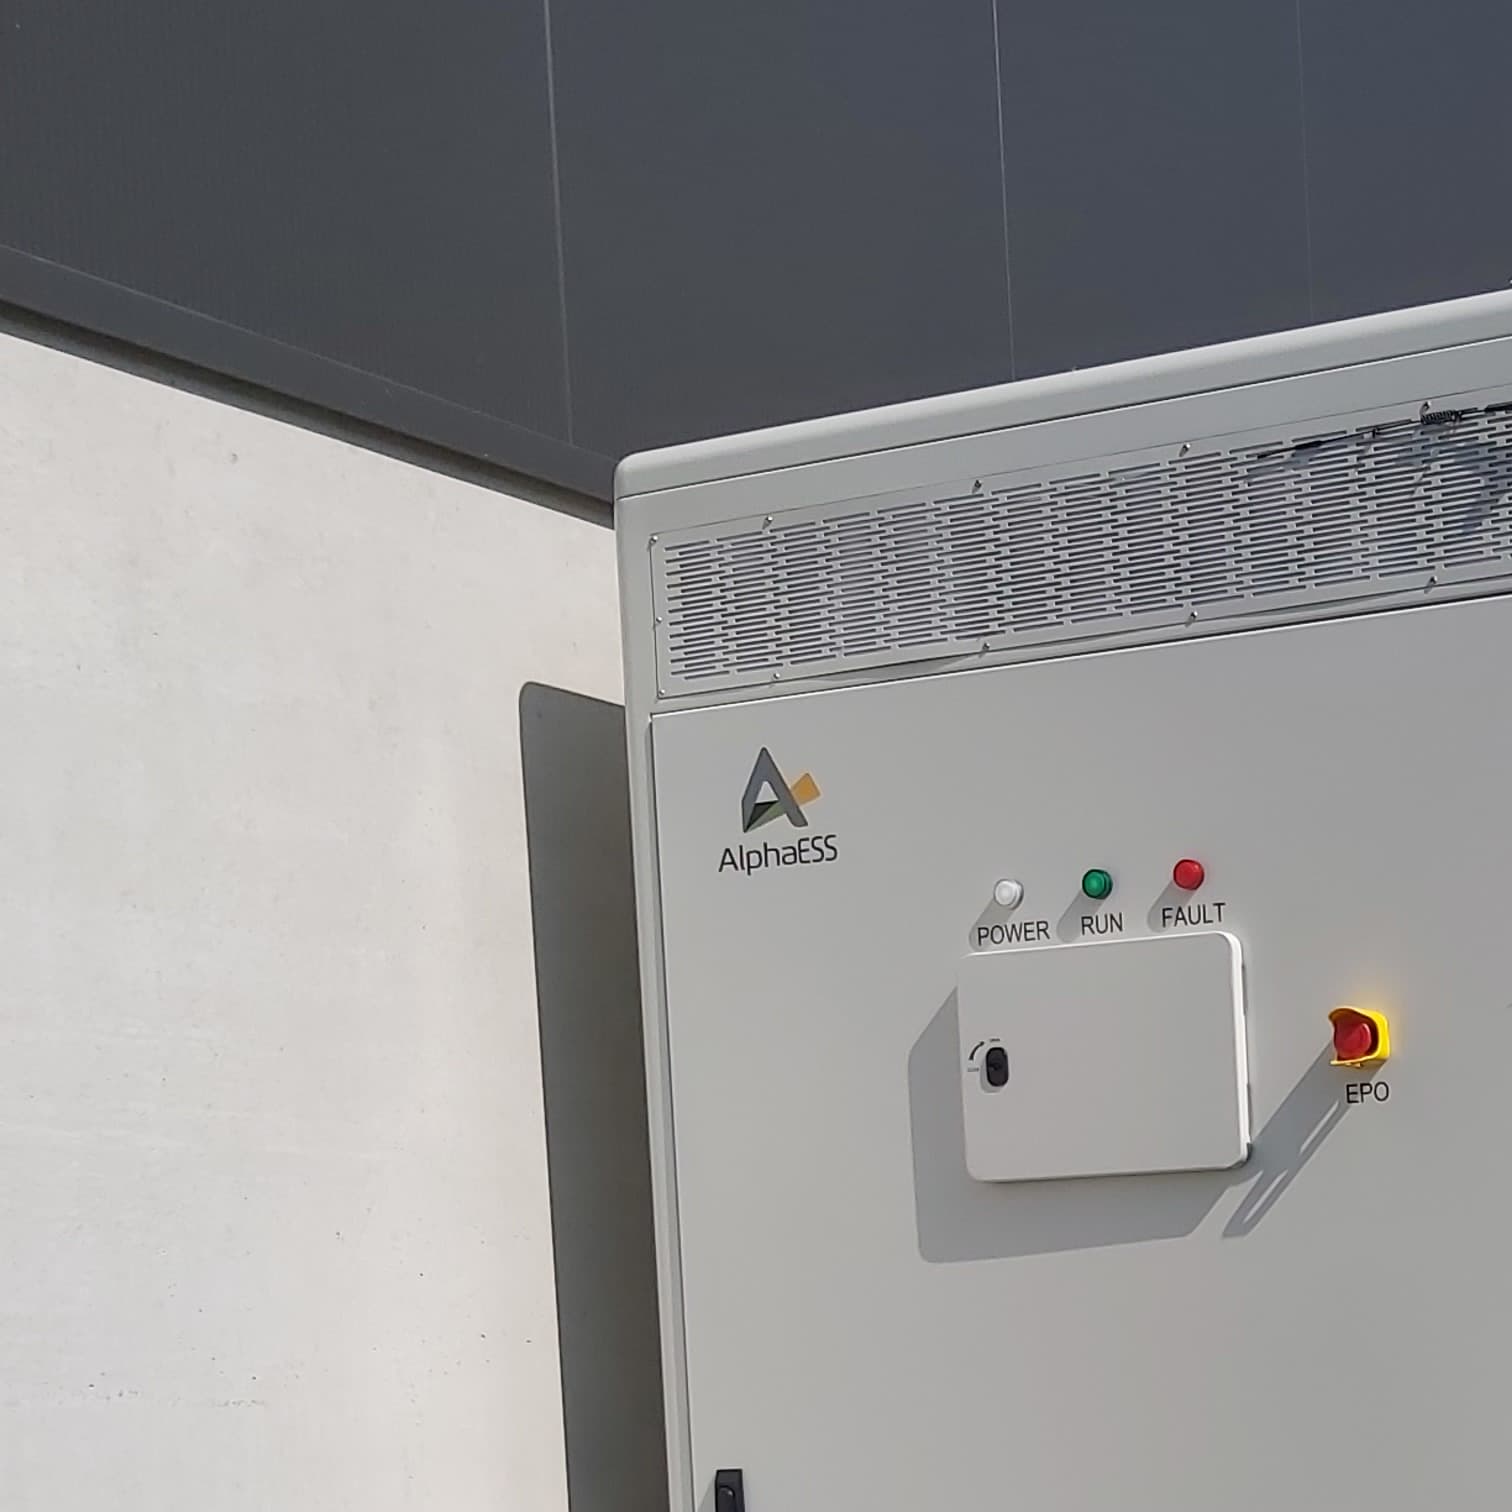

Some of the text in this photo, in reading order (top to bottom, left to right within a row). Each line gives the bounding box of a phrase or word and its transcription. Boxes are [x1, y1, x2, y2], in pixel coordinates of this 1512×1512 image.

[718, 834, 838, 876] AlphaESS
[1080, 912, 1123, 936] RUN
[1161, 902, 1226, 928] FAULT
[977, 920, 1050, 946] POWER
[1345, 1081, 1390, 1105] EPO
